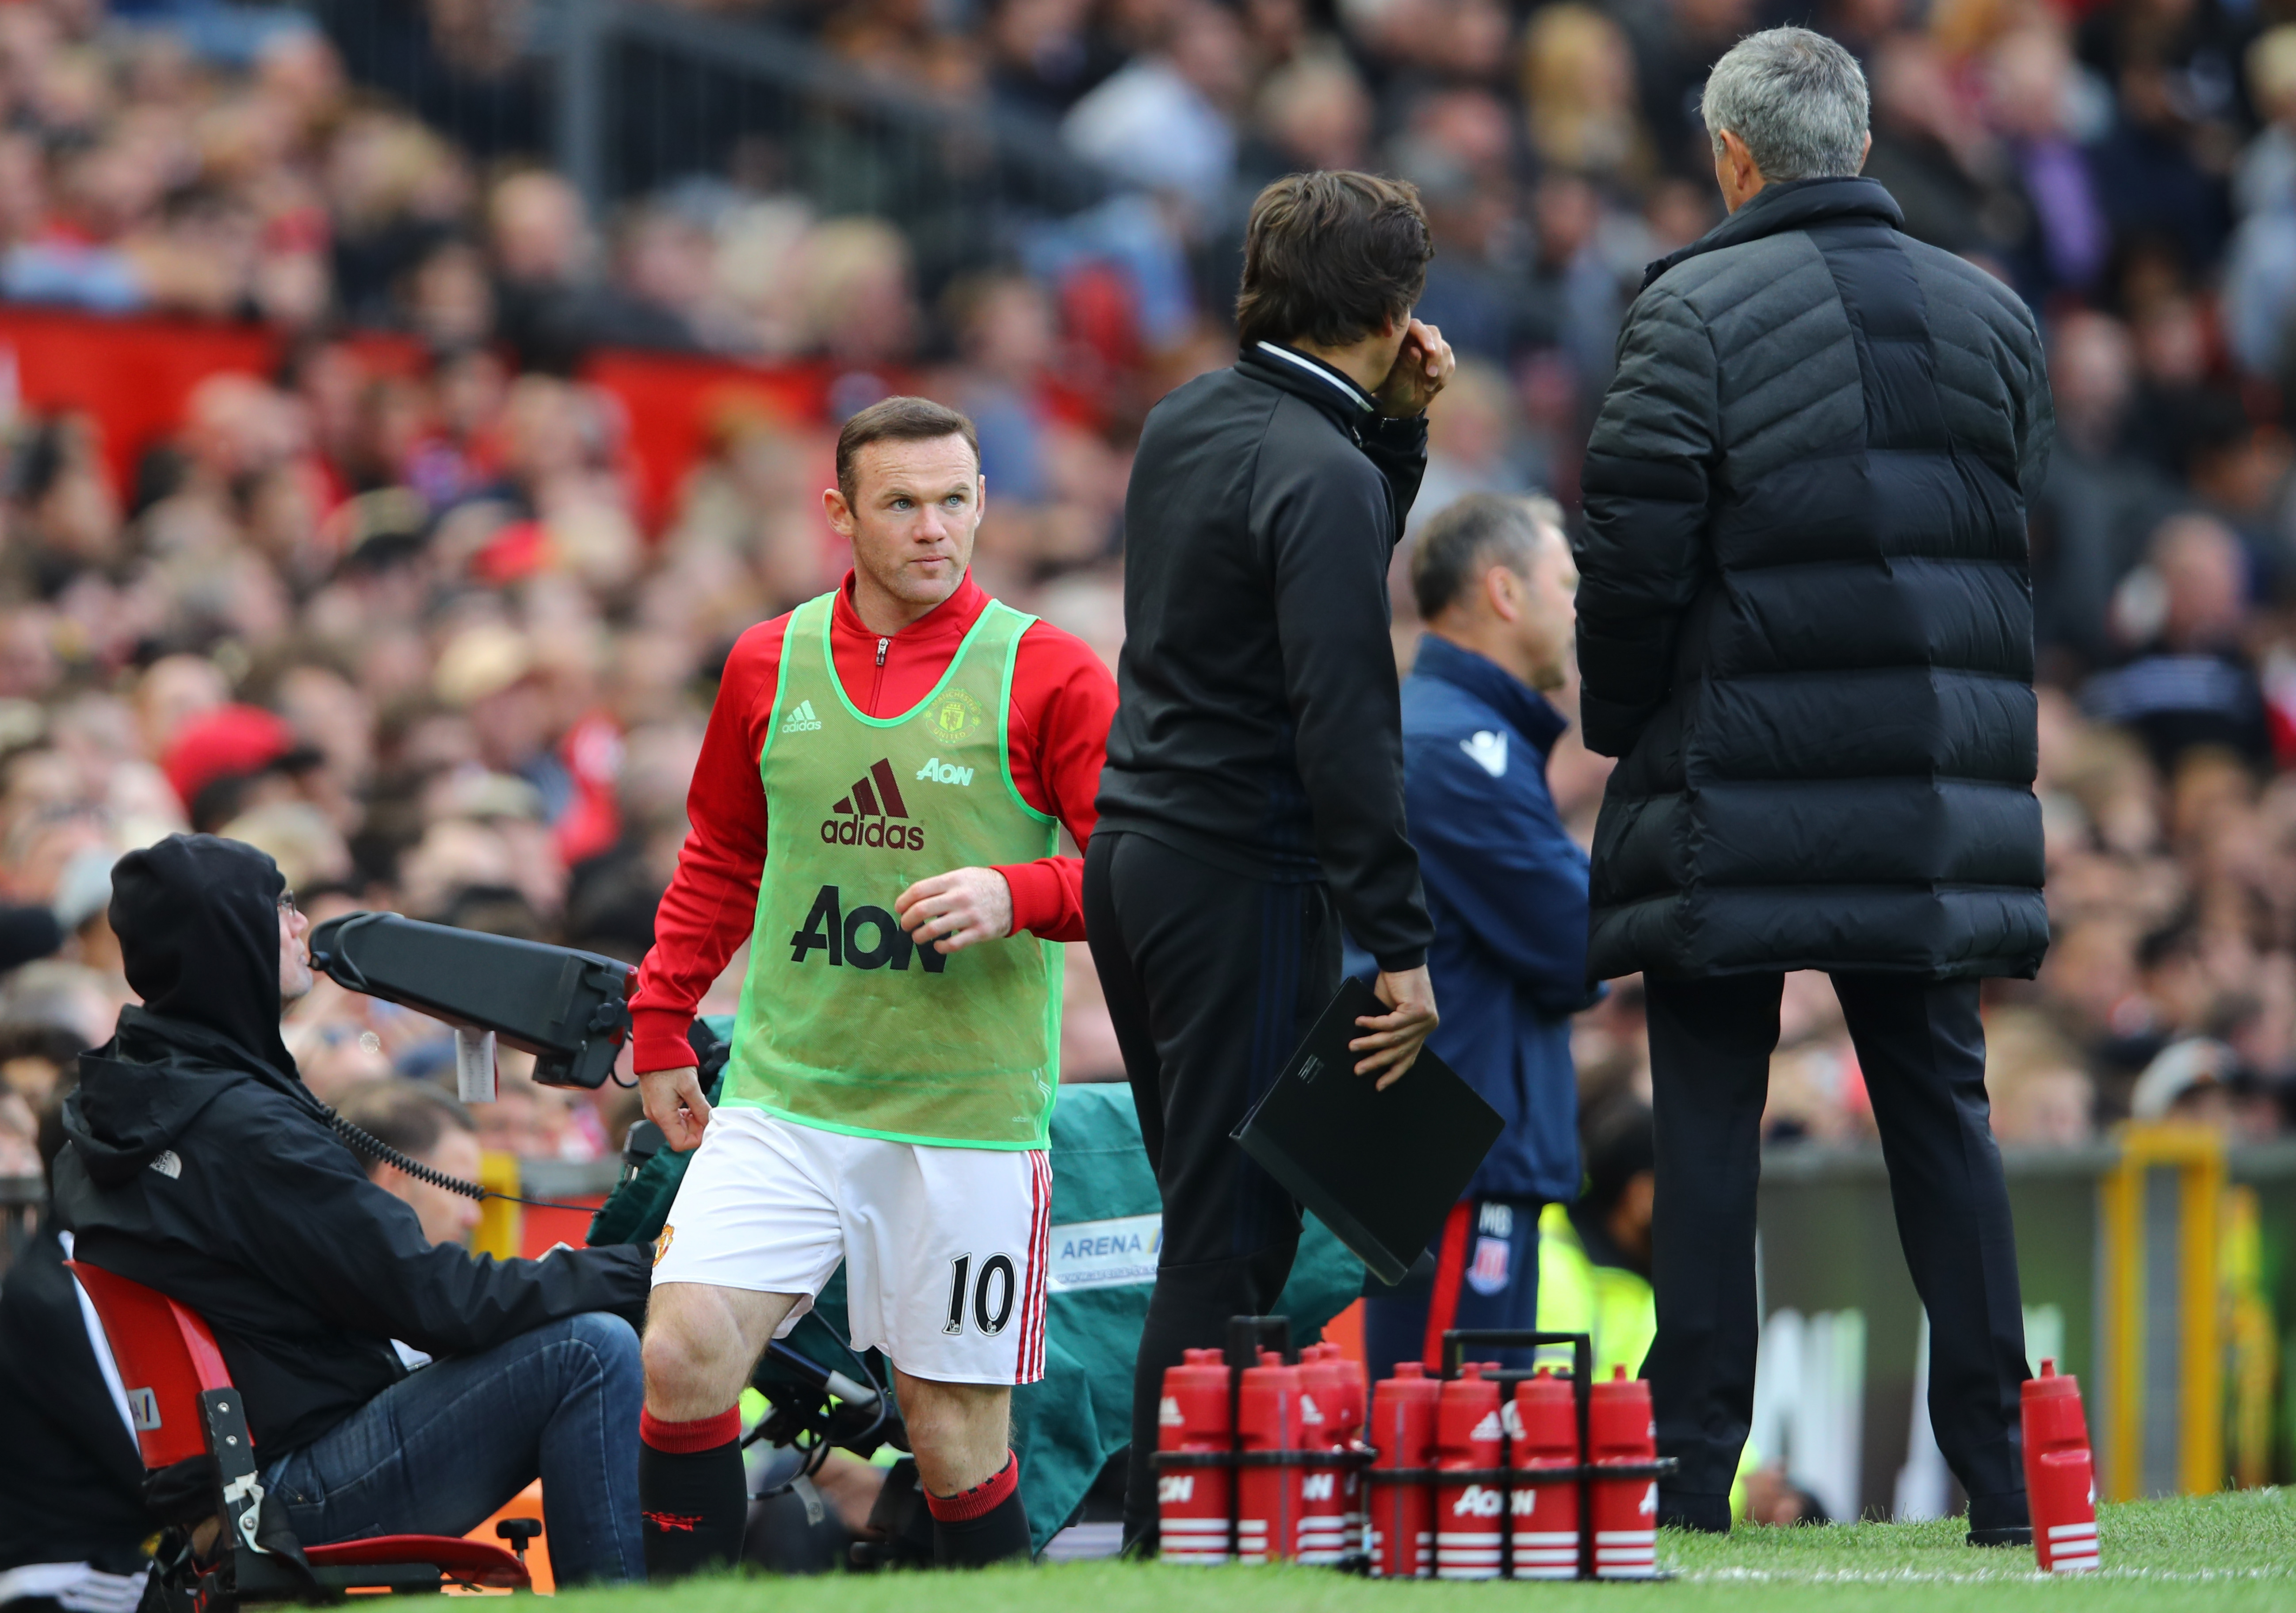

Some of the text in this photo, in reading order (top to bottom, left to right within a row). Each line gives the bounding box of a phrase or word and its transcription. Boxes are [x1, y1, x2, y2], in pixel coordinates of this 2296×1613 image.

[782, 720, 821, 734] adidas
[932, 728, 966, 739] UNITED
[821, 814, 924, 851] adidas
[1061, 1233, 1141, 1259] ARENA
[942, 1252, 1017, 1337] 10
